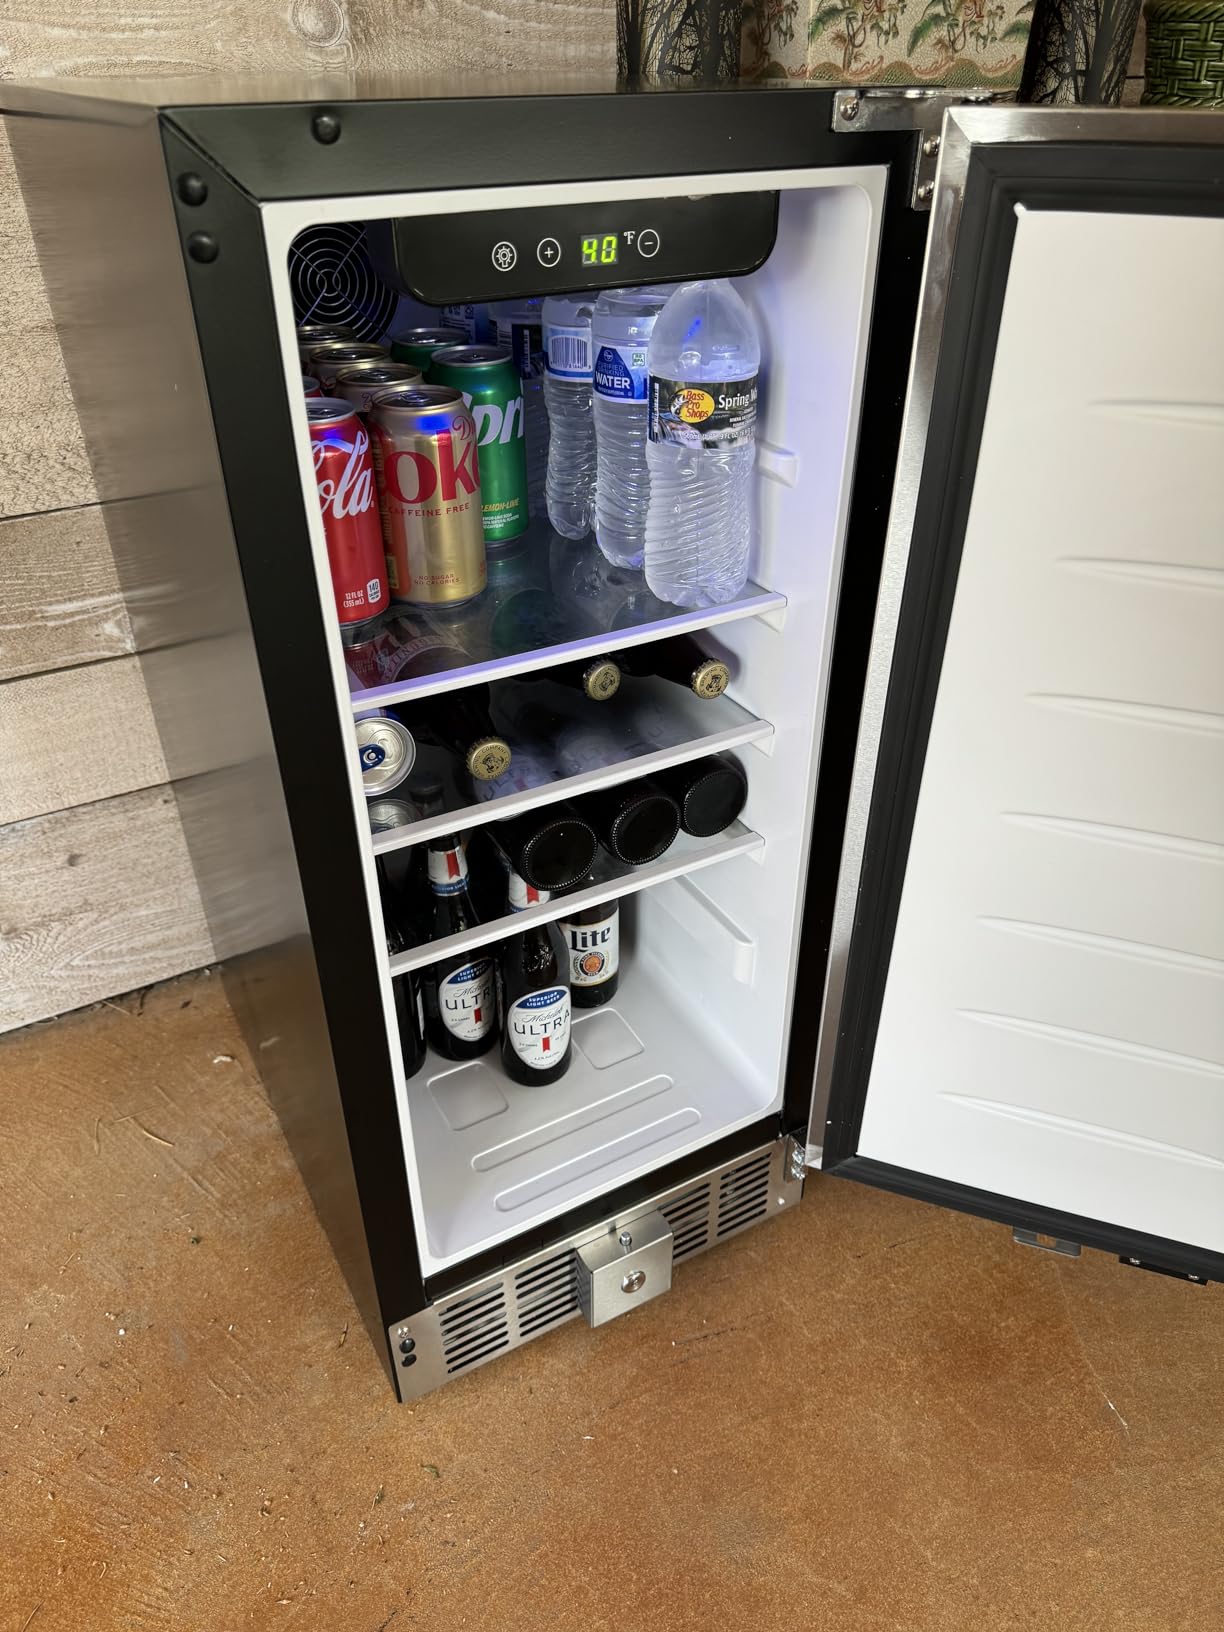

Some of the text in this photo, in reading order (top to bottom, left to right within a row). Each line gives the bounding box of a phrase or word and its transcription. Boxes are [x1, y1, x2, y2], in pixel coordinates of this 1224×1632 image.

[582, 236, 617, 264] 40
[595, 371, 631, 390] WATER
[686, 390, 705, 401] Bass
[687, 400, 701, 410] Pro
[718, 393, 750, 411] Spring
[686, 409, 709, 420] Shops
[446, 503, 470, 514] FREE
[369, 581, 379, 592] 140
[345, 592, 352, 600] 12
[569, 927, 611, 952] Lite
[445, 988, 491, 1010] ULTR
[526, 994, 560, 1007] LIGHT BEER
[528, 991, 558, 1002] SUPERIOR
[514, 1010, 570, 1035] ULTRA
